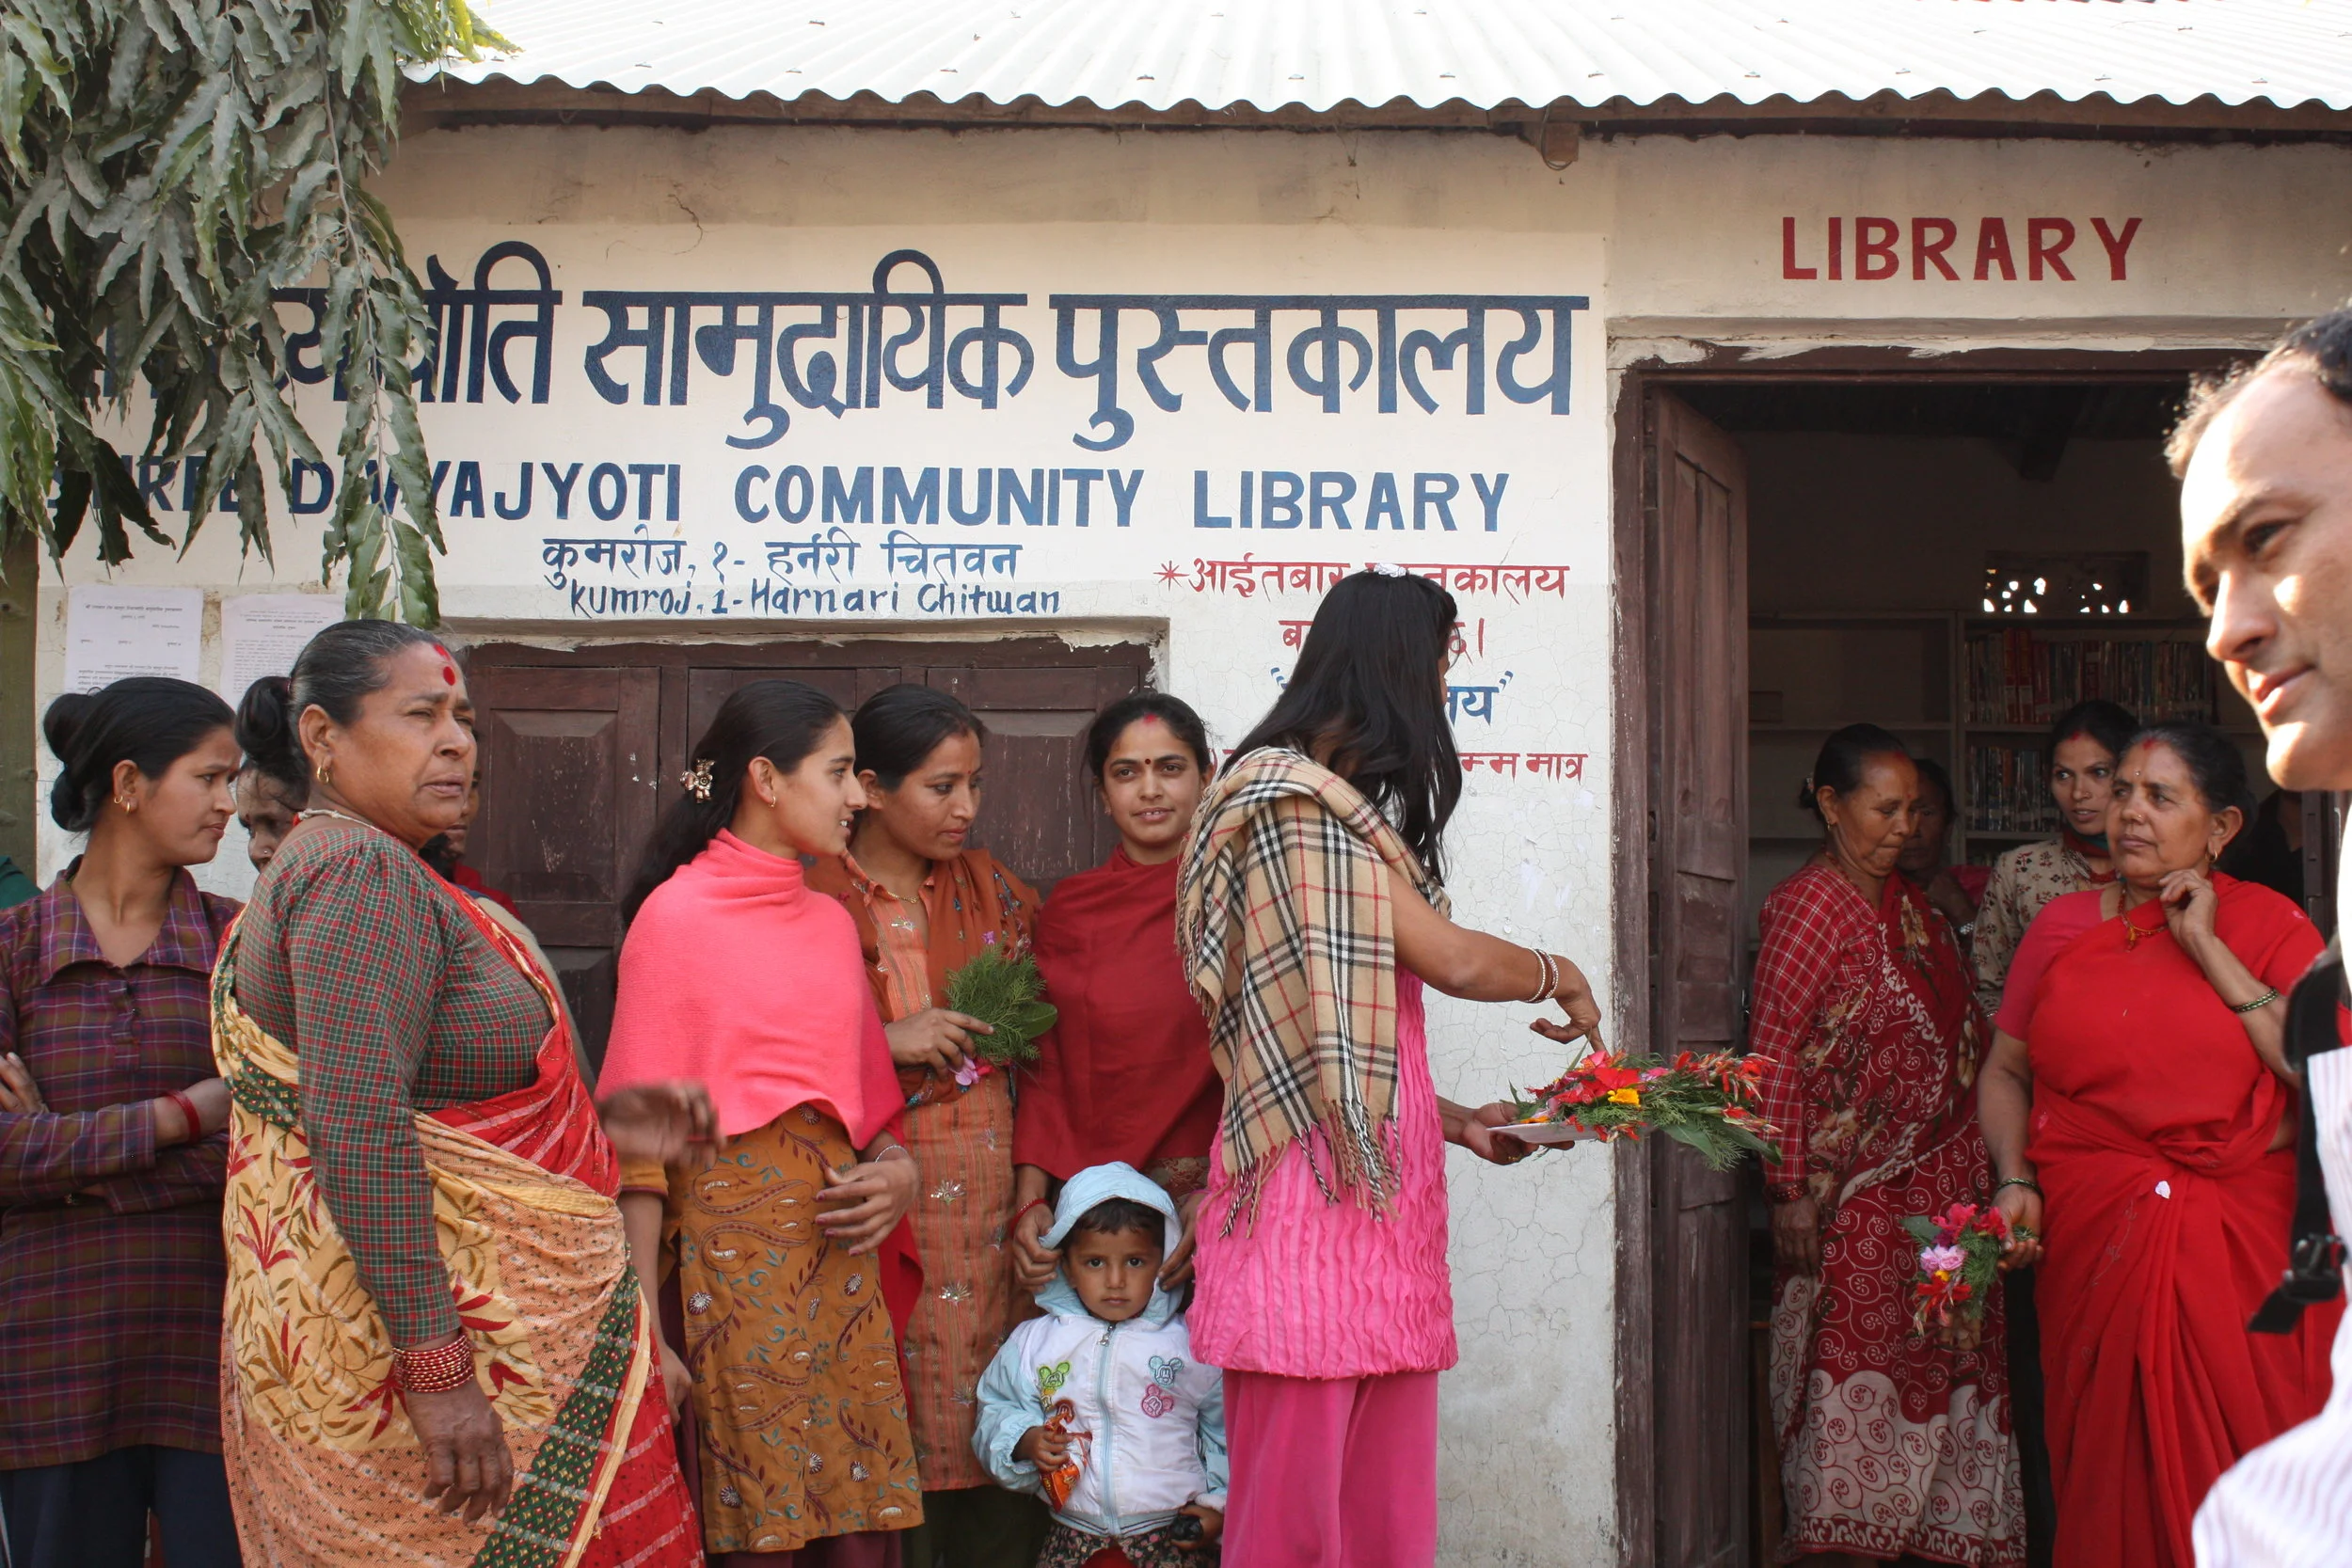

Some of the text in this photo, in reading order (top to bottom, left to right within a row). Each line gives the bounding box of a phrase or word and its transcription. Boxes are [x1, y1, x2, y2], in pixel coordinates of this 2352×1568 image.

[1782, 216, 2143, 281] LIBRARY
[582, 249, 1034, 450] सामुदायिक
[1049, 293, 1590, 451] पुस्तकालय
[290, 457, 680, 521] DVAJYOTI
[734, 464, 1145, 528] COMMUNITY
[1193, 469, 1510, 532] LIBRARY
[880, 529, 1024, 583] चितवन
[916, 581, 1060, 616] Chitwan
[1525, 752, 1589, 785] मात्र
